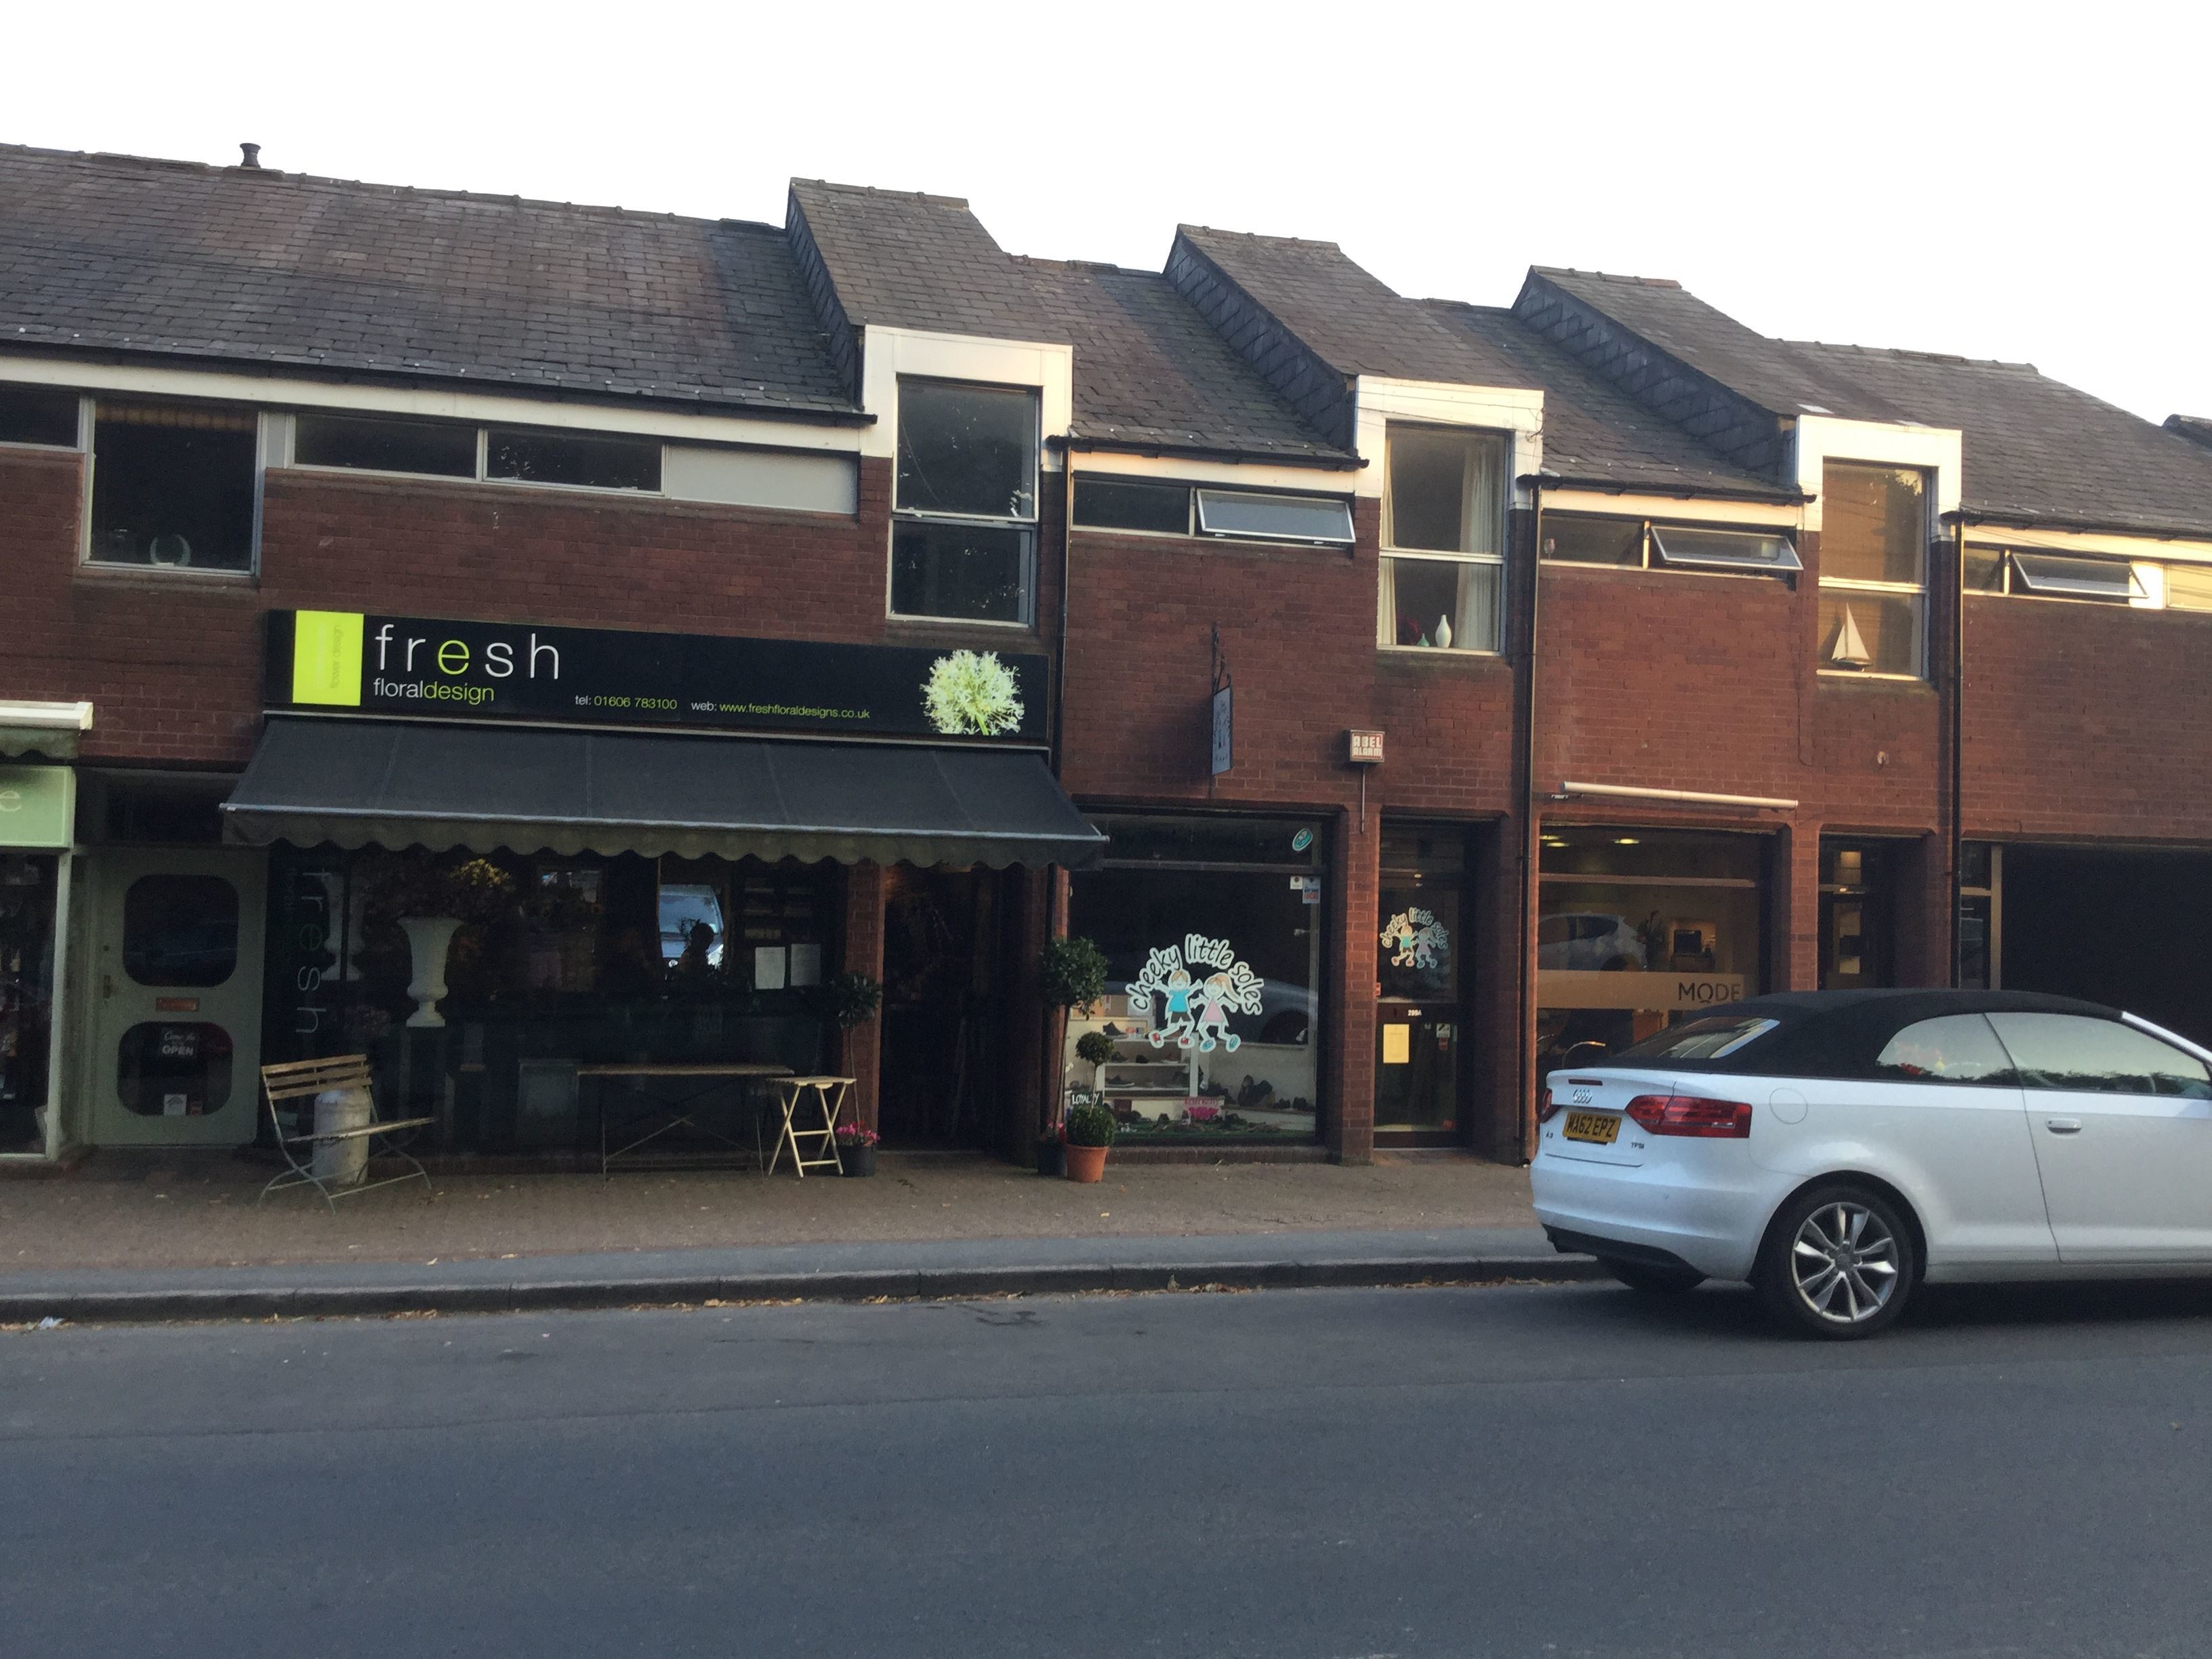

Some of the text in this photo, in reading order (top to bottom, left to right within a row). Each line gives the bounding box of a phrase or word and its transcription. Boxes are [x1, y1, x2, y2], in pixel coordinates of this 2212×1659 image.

[374, 623, 559, 680] fresh
[575, 695, 871, 720] tel: 01606 783100 web: www.freshfloraldesigns.co.uk
[1353, 735, 1382, 747] ABEL
[1353, 747, 1382, 757] ALARM
[1380, 907, 1449, 949] cheeky little soles
[1126, 934, 1263, 1015] cheeky little soles
[1678, 981, 1740, 1004] MODE
[162, 1044, 194, 1057] OPEN
[1071, 1092, 1100, 1105] LOYALY
[1593, 1117, 1616, 1138] EPZ
